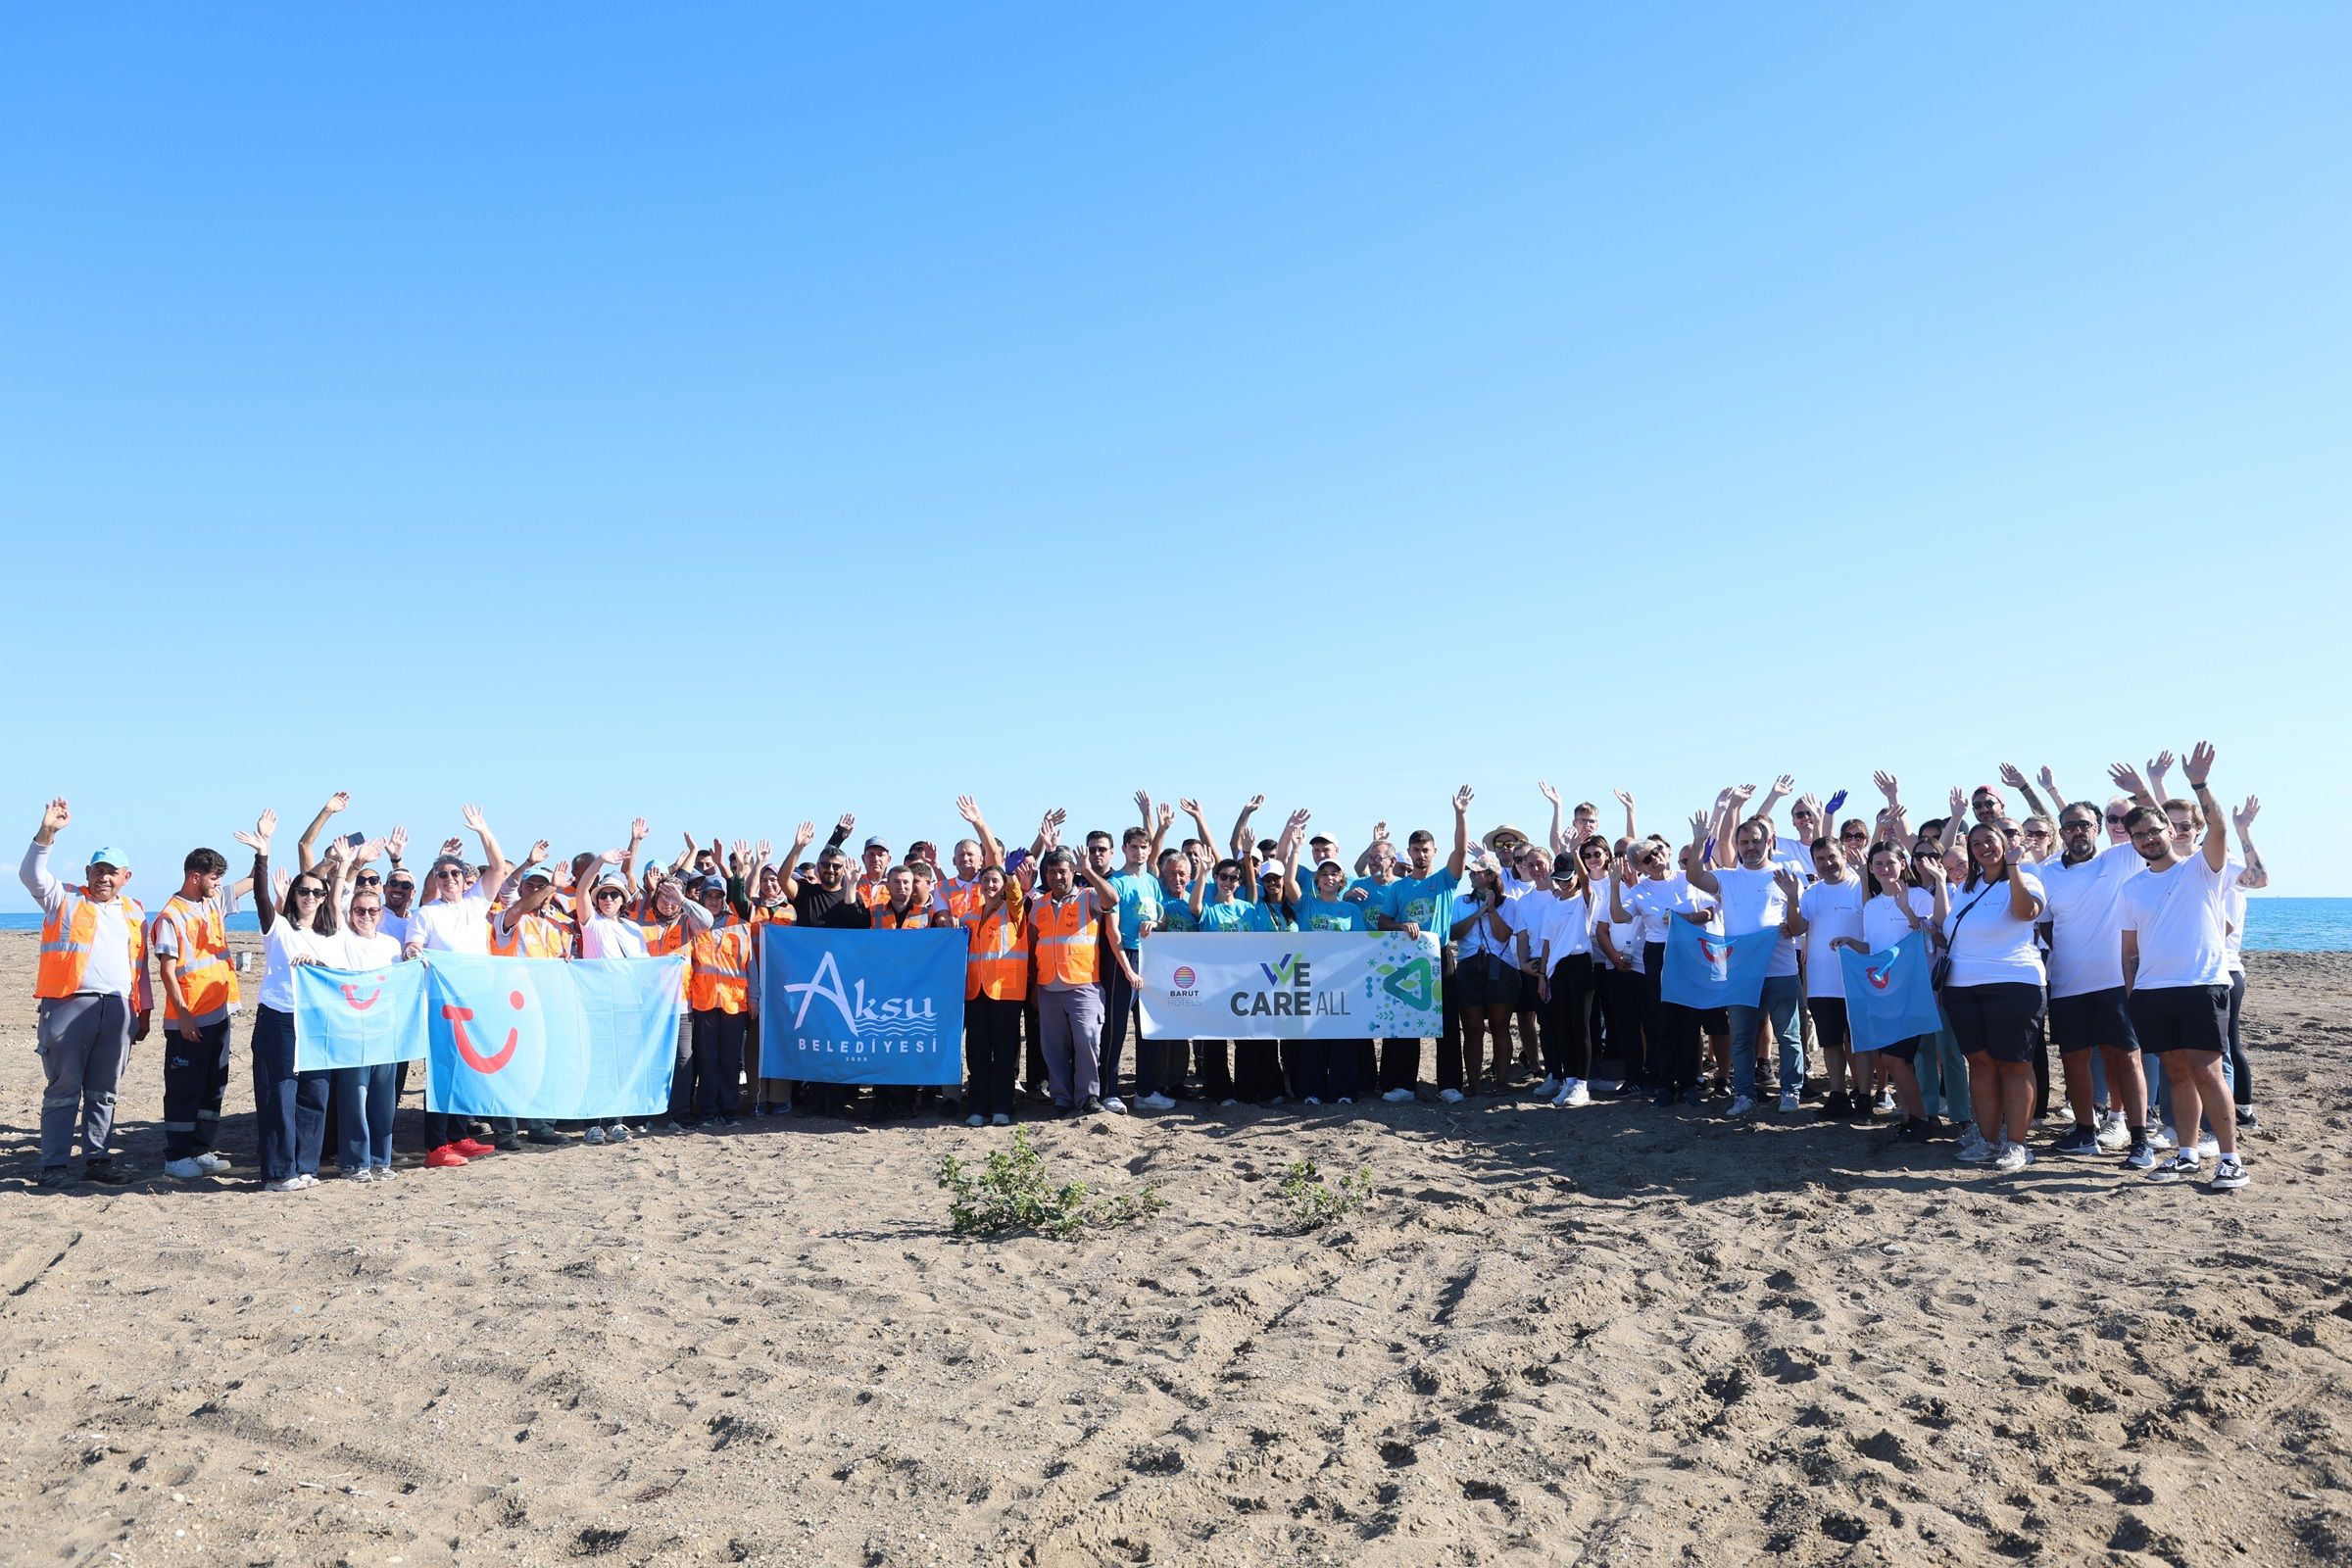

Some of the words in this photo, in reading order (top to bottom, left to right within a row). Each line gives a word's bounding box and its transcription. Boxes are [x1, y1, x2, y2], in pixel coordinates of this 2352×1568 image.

[1259, 954, 1311, 987] WE
[784, 951, 938, 1038] Aksu
[1230, 992, 1311, 1016] CARE
[1316, 992, 1351, 1015] ALL
[799, 1037, 937, 1054] BELEDİYESİ
